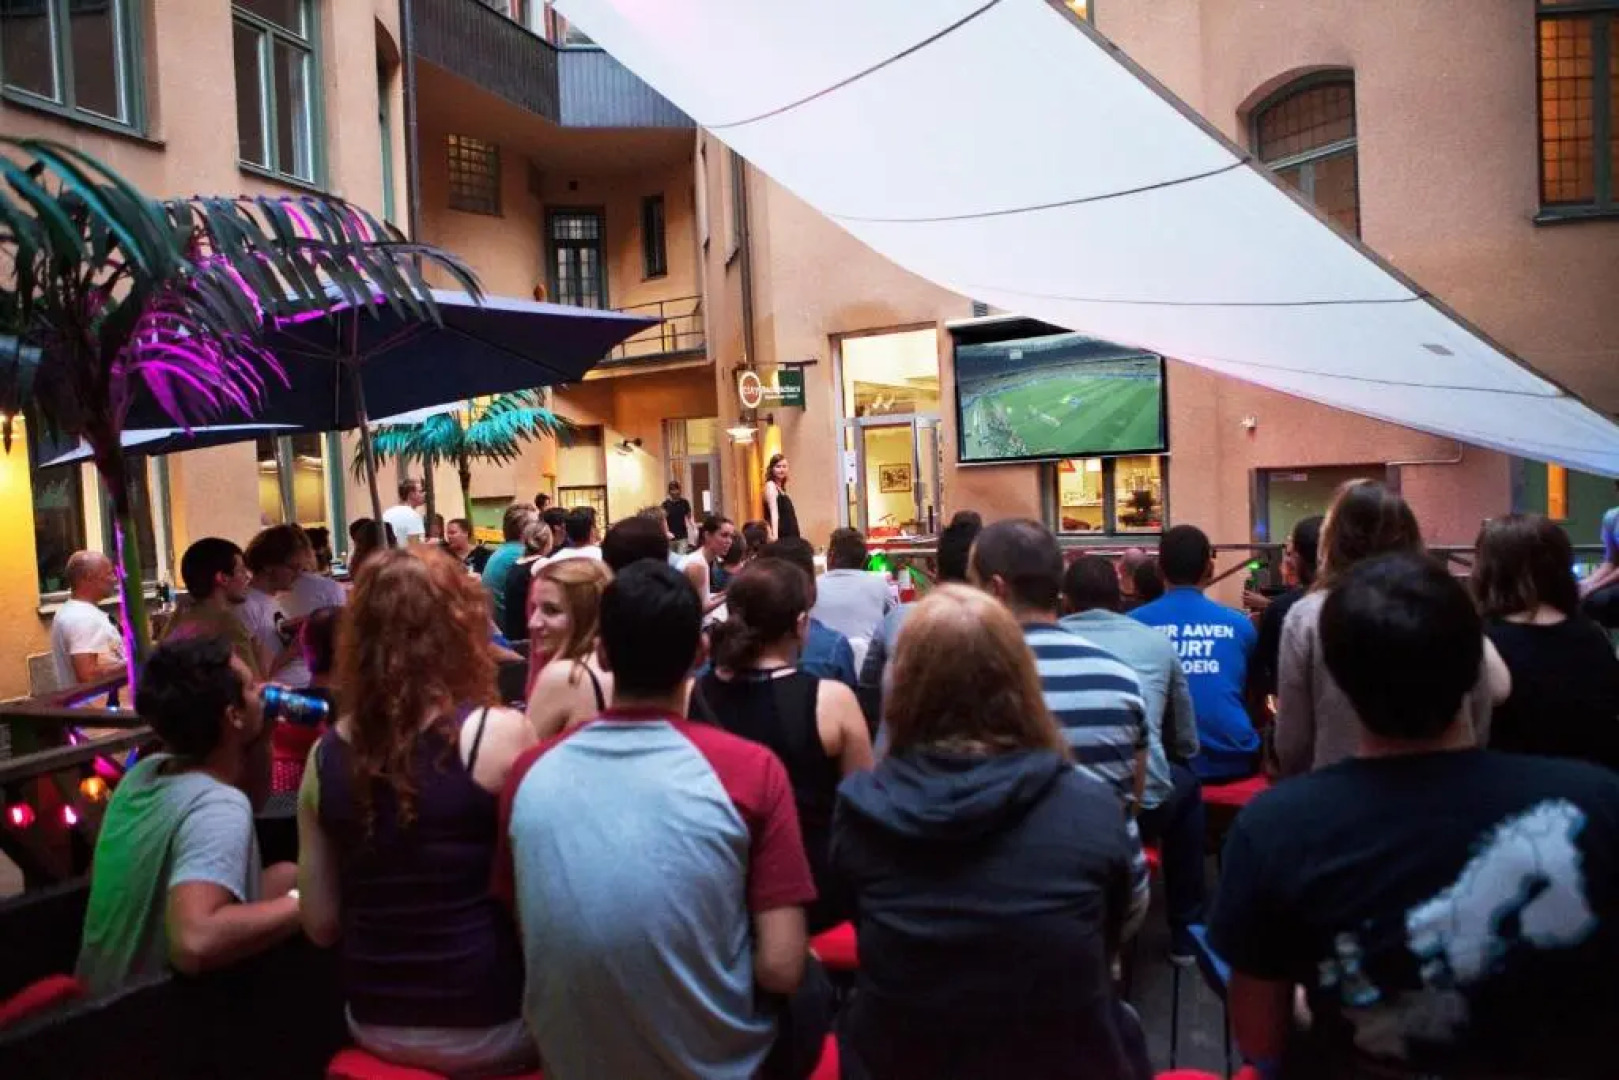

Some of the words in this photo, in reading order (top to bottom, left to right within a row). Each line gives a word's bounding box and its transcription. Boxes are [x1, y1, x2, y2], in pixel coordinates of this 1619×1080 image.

[1182, 624, 1234, 638] AAVEN
[1172, 639, 1215, 657] URT
[1181, 659, 1220, 673] OEIG
